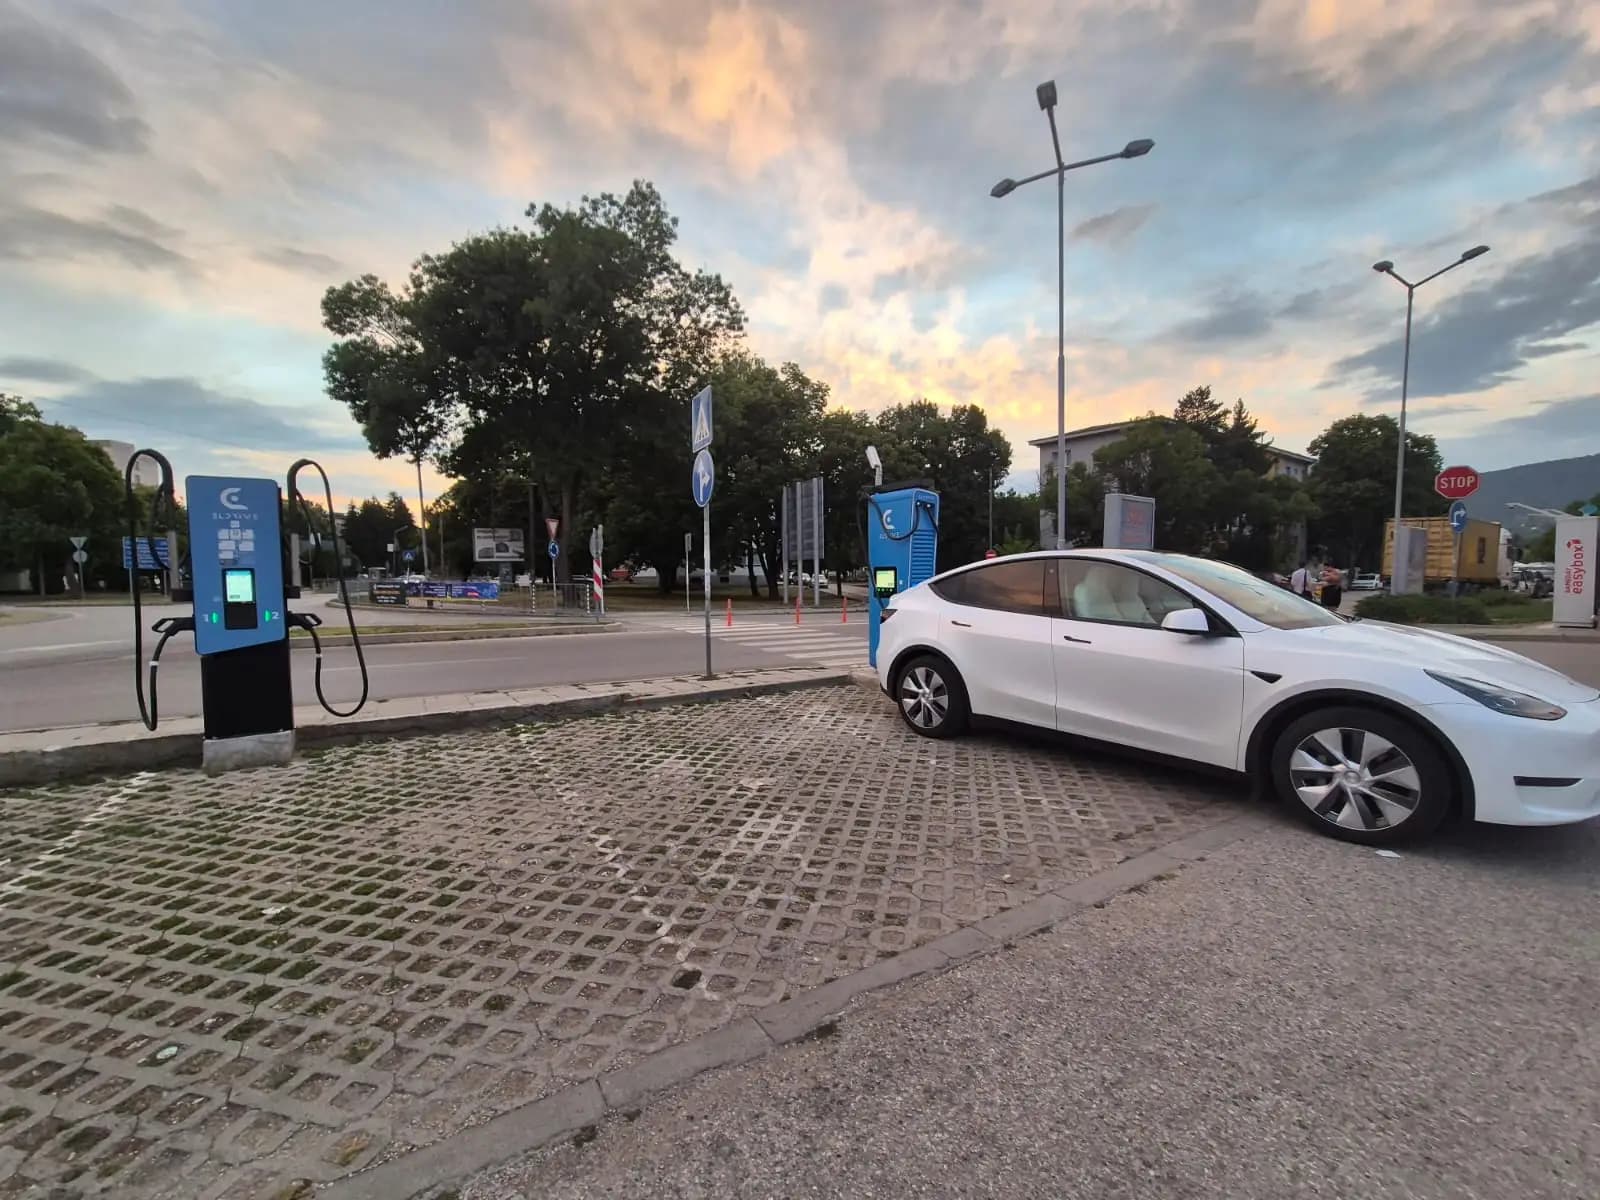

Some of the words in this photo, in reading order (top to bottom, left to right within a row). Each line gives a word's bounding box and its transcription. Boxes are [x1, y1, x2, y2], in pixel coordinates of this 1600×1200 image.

[1440, 475, 1476, 489] STOP
[1570, 545, 1586, 594] easybox
[271, 611, 280, 620] 2
